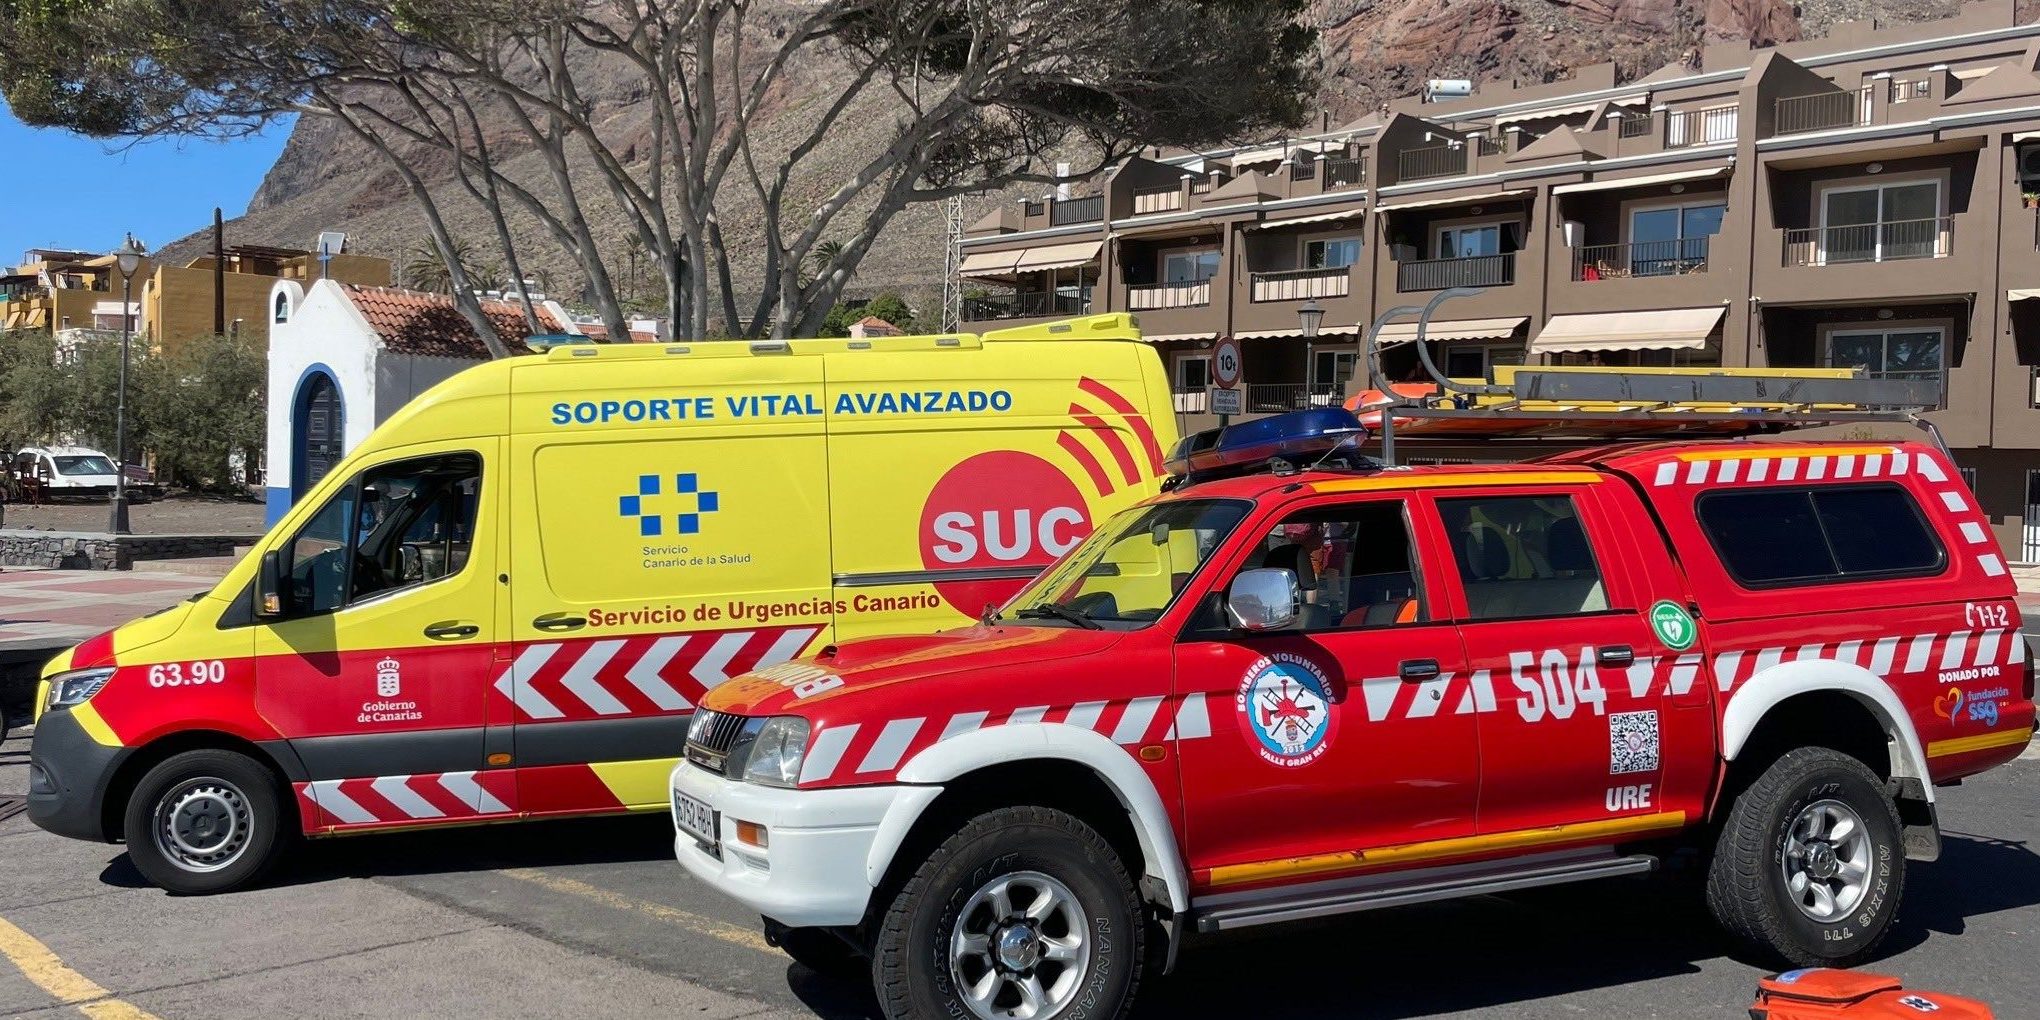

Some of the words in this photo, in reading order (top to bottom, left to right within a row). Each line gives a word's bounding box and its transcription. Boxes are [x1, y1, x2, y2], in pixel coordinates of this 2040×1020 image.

[551, 397, 714, 425] SOPORTE
[725, 393, 824, 417] VITAL
[834, 390, 1012, 414] AVANZADO
[932, 506, 1085, 563] SUC
[642, 545, 688, 556] Servicio
[643, 558, 687, 569] Canario
[689, 556, 703, 566] de
[706, 556, 716, 565] la
[719, 553, 751, 564] Salud
[588, 605, 687, 627] Servicio
[693, 603, 721, 621] de
[728, 597, 847, 622] Urgencias
[853, 591, 940, 612] Canario
[149, 660, 225, 687] 63.90
[1236, 656, 1272, 712] BOMBEROS
[1272, 652, 1336, 704] VOLUNTARIOS
[1508, 646, 1608, 723] 504
[1938, 668, 1979, 683] DONADO
[1981, 666, 2000, 678] POR
[362, 700, 416, 712] Gobierno
[1968, 686, 2009, 701] fundación
[357, 712, 371, 723] de
[372, 710, 422, 722] Canarias
[1259, 747, 1285, 766] VALLE
[1286, 754, 1313, 766] GRAN
[1313, 741, 1328, 758] REY
[677, 795, 697, 829] 6752
[1605, 783, 1652, 812] URE
[1858, 844, 1891, 927] MAXXIS
[1066, 917, 1112, 1020] NANKAN
